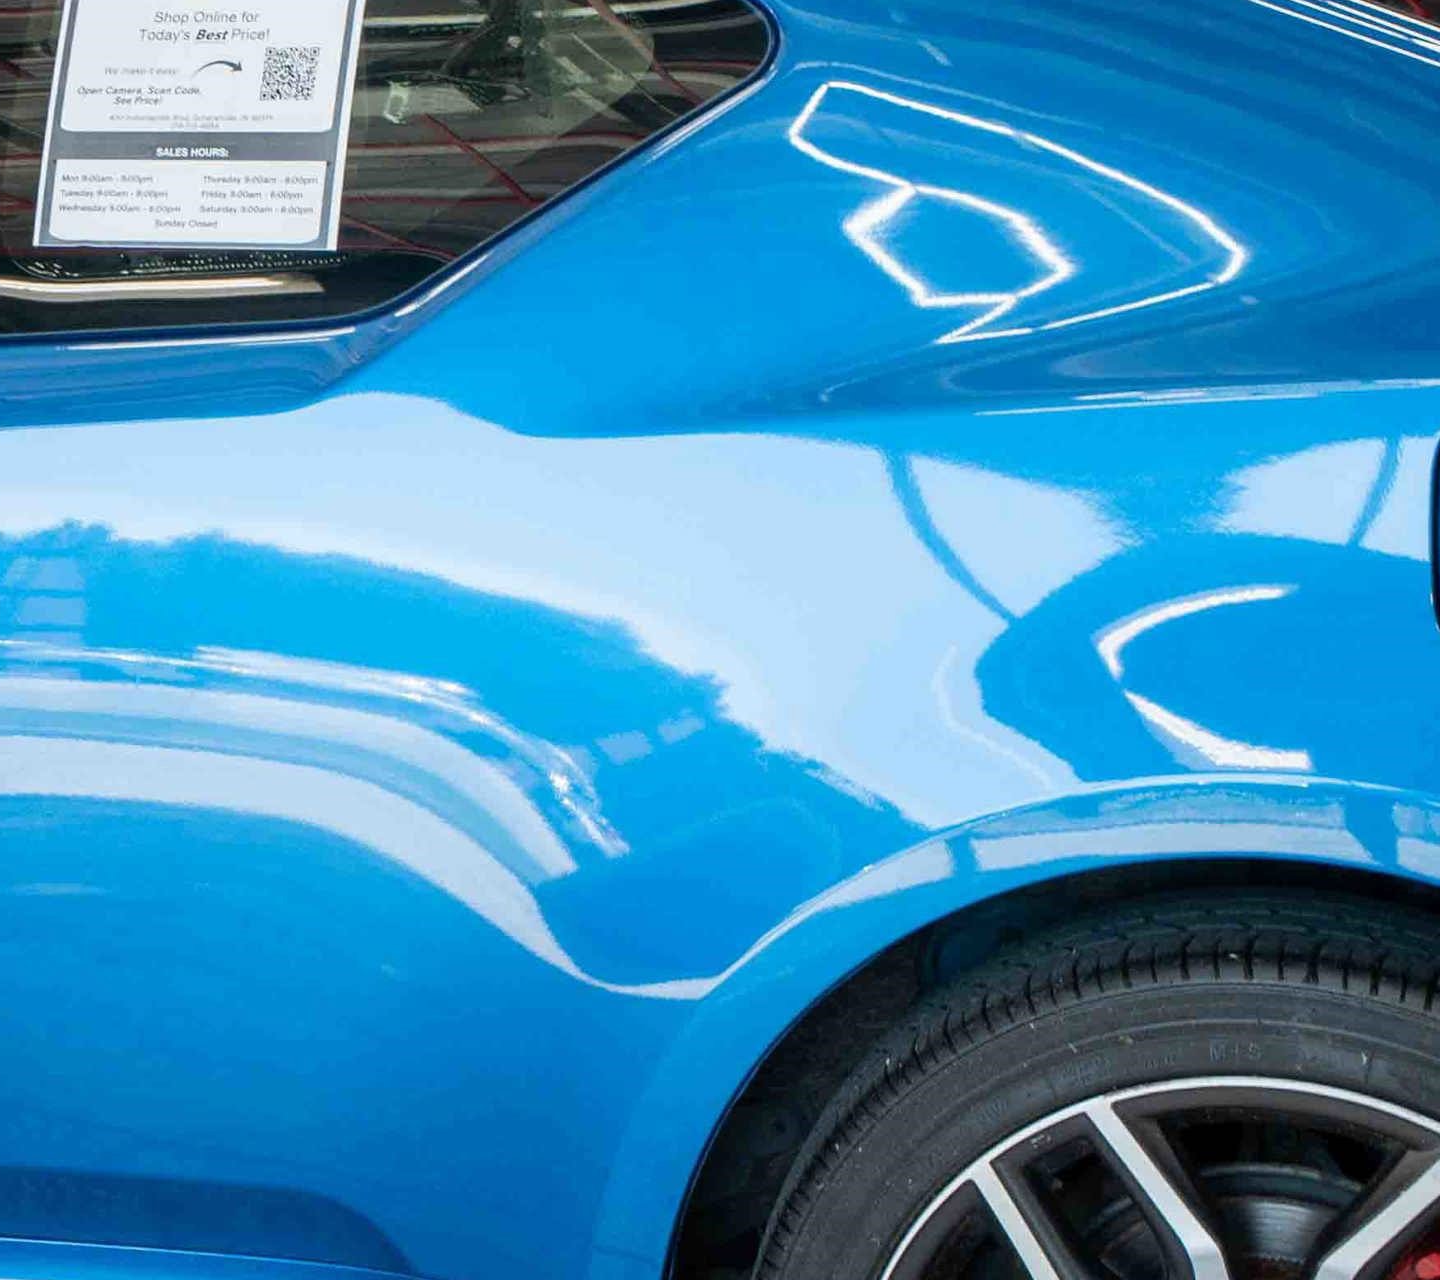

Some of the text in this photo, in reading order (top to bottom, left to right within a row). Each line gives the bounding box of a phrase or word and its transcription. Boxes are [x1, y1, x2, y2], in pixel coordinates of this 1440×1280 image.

[154, 9, 260, 25] Shop Online for
[138, 28, 270, 43] Today's Best Price!
[77, 86, 103, 97] Open
[147, 85, 172, 95] Scan
[113, 95, 132, 105] See
[155, 147, 229, 158] SALES HOURS:
